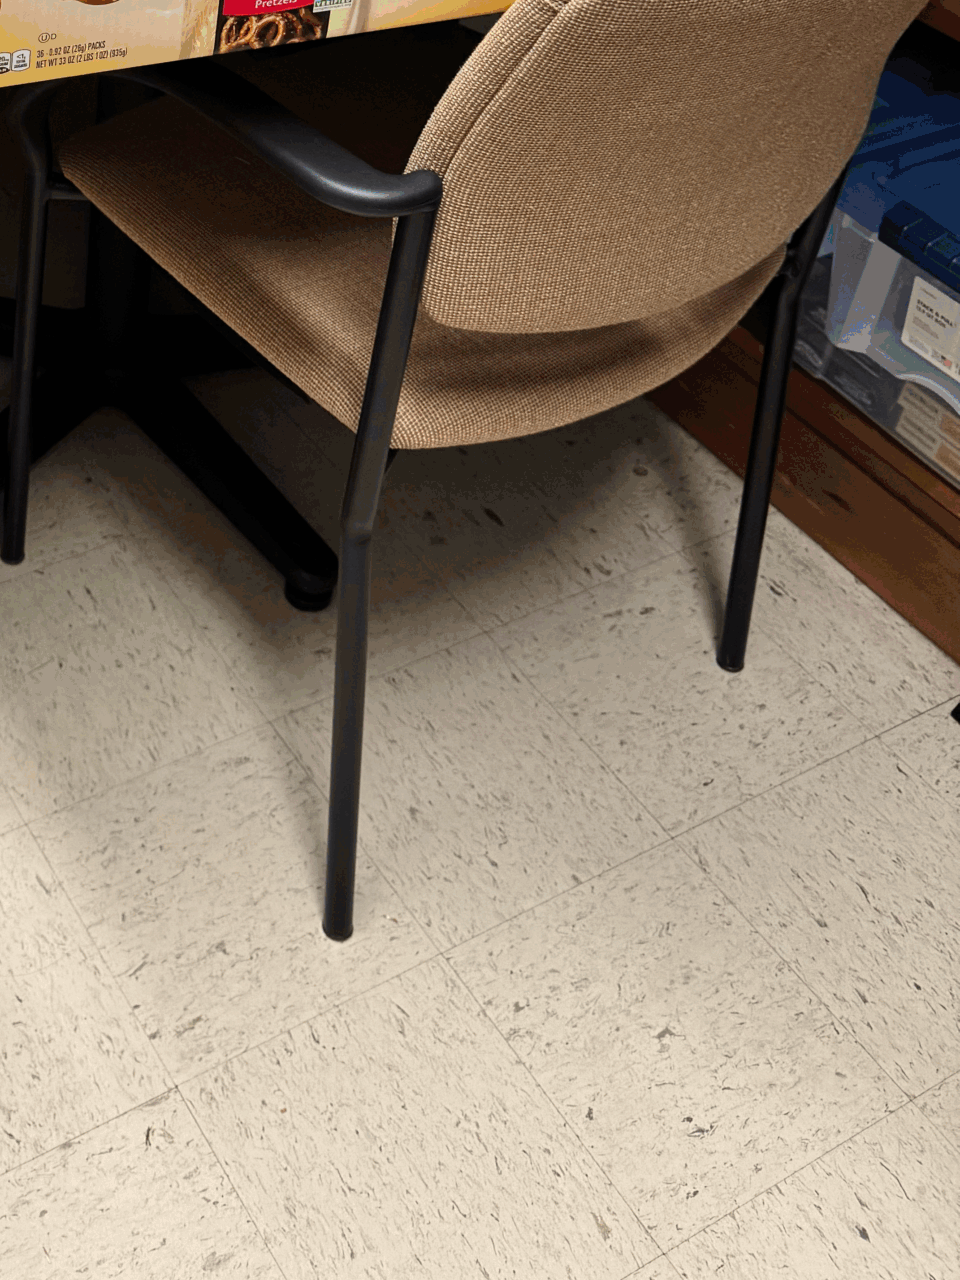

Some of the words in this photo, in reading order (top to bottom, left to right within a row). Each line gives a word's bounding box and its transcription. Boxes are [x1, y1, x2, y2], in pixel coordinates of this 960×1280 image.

[48, 46, 62, 57] 0.92
[88, 40, 106, 51] PACKS
[35, 59, 47, 69] NET
[48, 57, 58, 68] WT
[59, 56, 67, 66] 33
[68, 55, 76, 65] OZ
[83, 52, 94, 62] LBS
